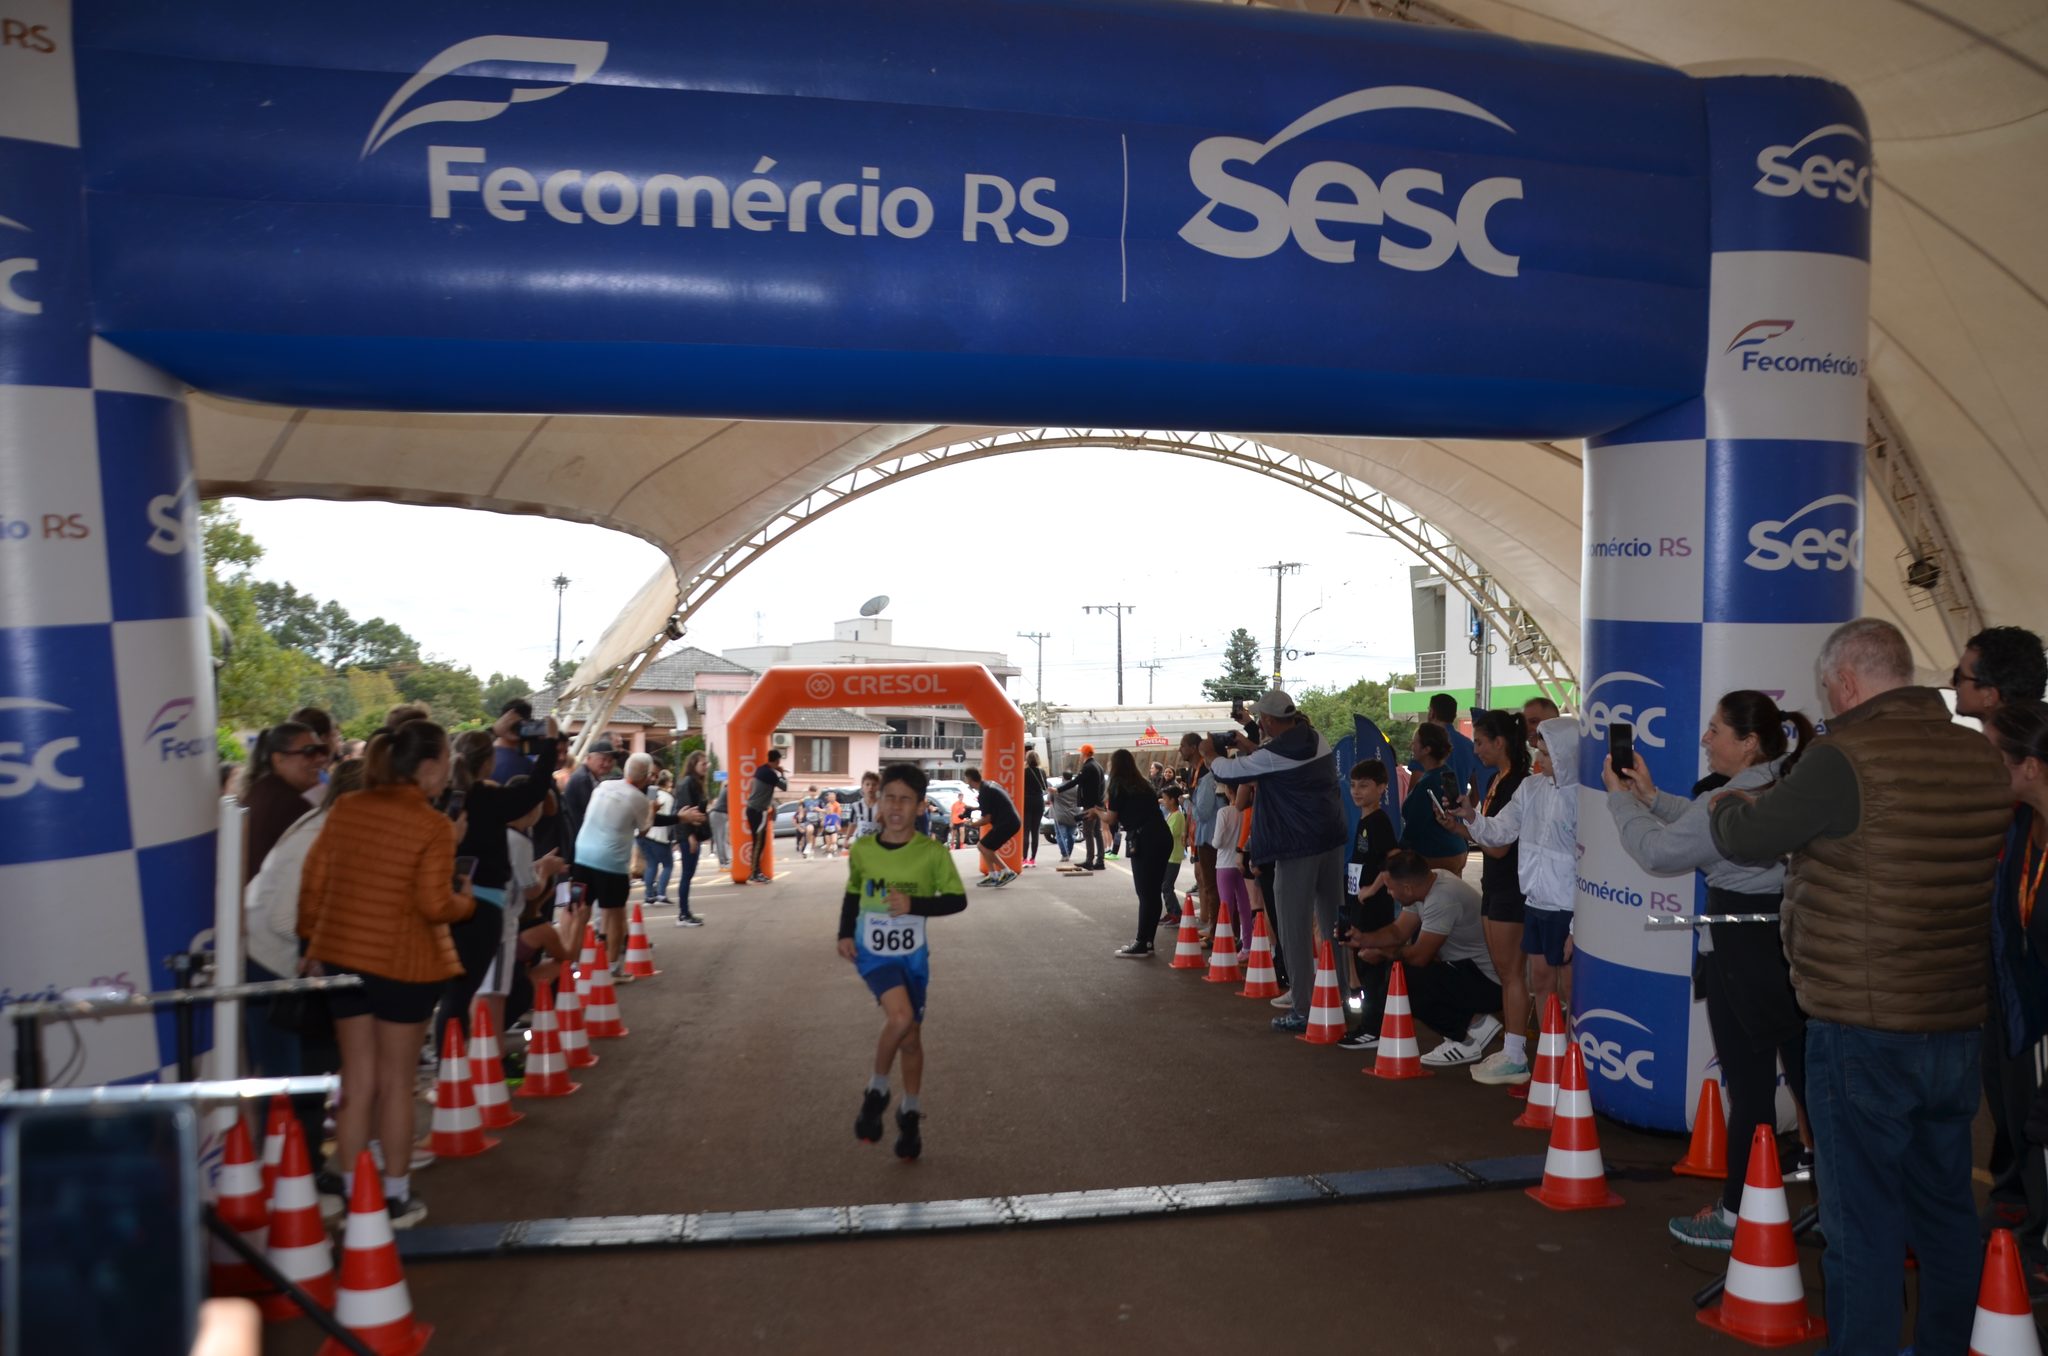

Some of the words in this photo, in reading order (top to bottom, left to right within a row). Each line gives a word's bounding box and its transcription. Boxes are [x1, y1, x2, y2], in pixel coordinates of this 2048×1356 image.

[2, 18, 56, 54] RS
[428, 145, 935, 240] Fecomércio
[963, 173, 1070, 248] RS
[1178, 135, 1524, 278] Sesc
[1742, 350, 1858, 376] Fecomércio
[42, 514, 90, 540] RS
[1659, 537, 1693, 558] RS
[843, 673, 949, 695] CRESOL
[1580, 701, 1666, 748] esc
[1576, 875, 1644, 907] comércio
[1649, 891, 1683, 913] RS
[872, 928, 915, 951] 968
[1573, 1031, 1655, 1090] esc
